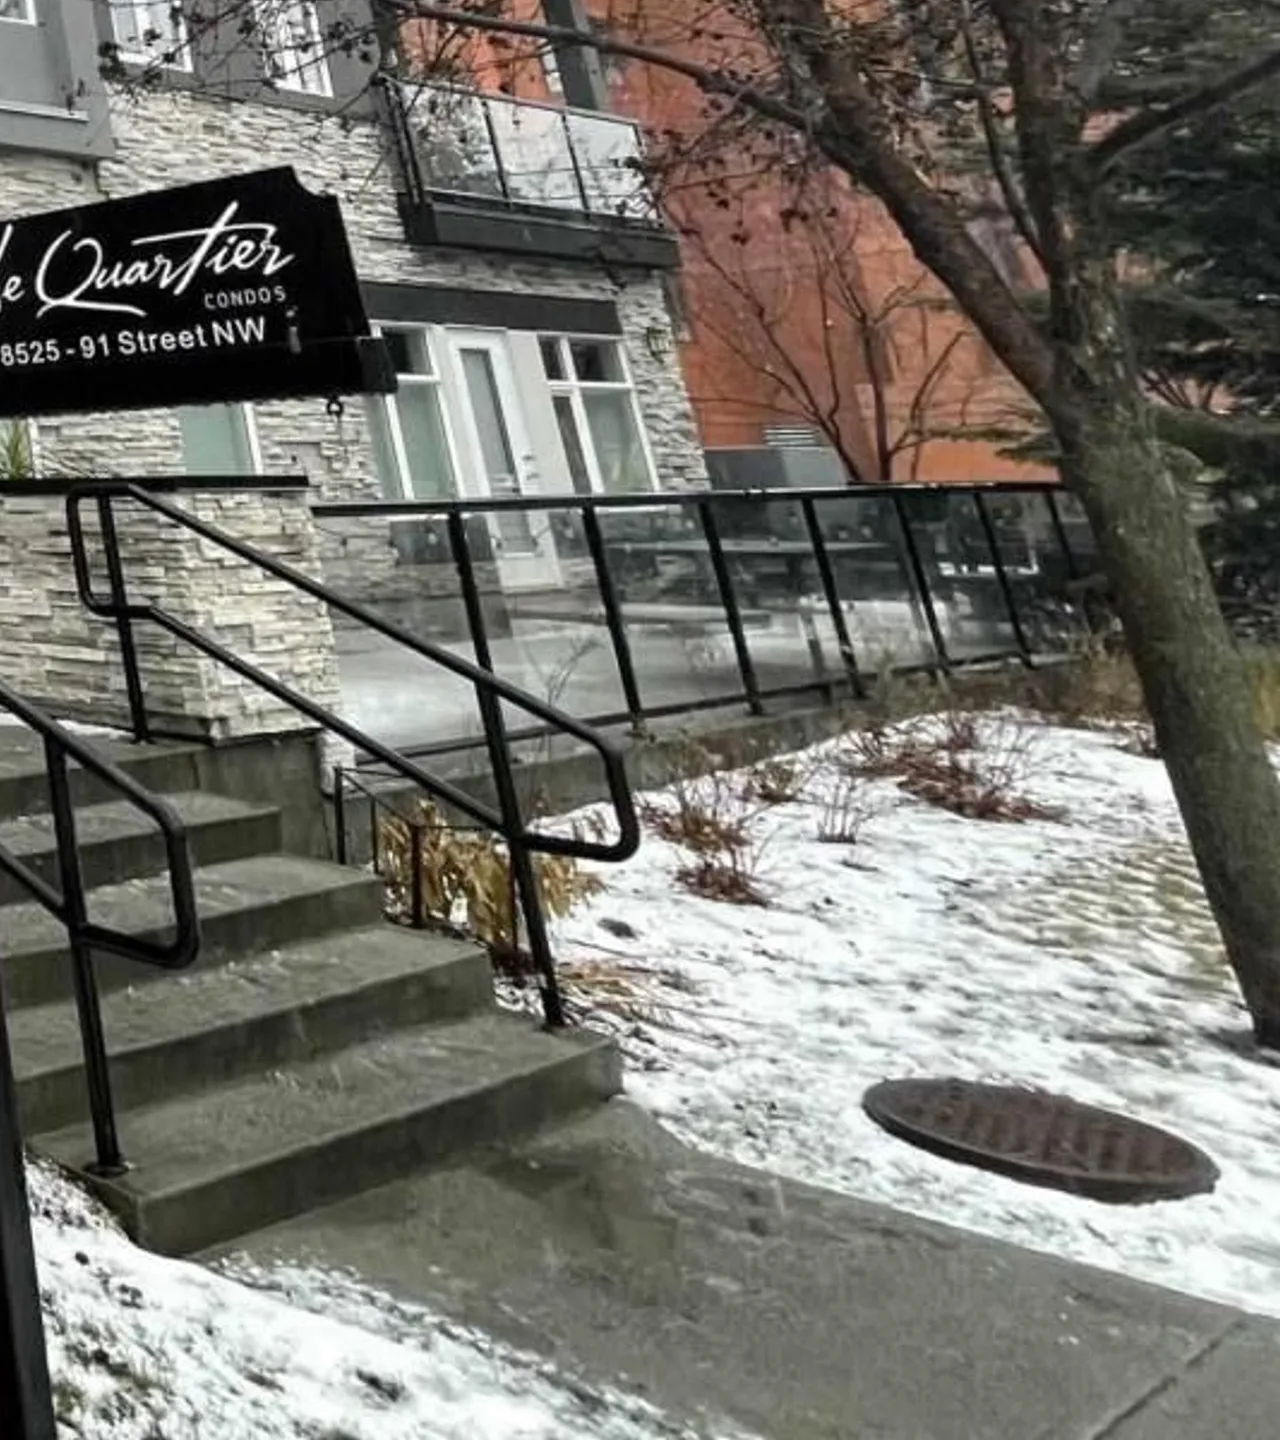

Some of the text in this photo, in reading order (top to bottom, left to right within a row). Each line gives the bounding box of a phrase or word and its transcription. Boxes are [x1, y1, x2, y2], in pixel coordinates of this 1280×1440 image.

[34, 199, 296, 319] Quartier
[203, 285, 287, 310] CONDOS
[0, 337, 61, 367] 8525
[78, 332, 110, 359] 91
[117, 323, 208, 356] Street
[210, 315, 266, 347] NW
